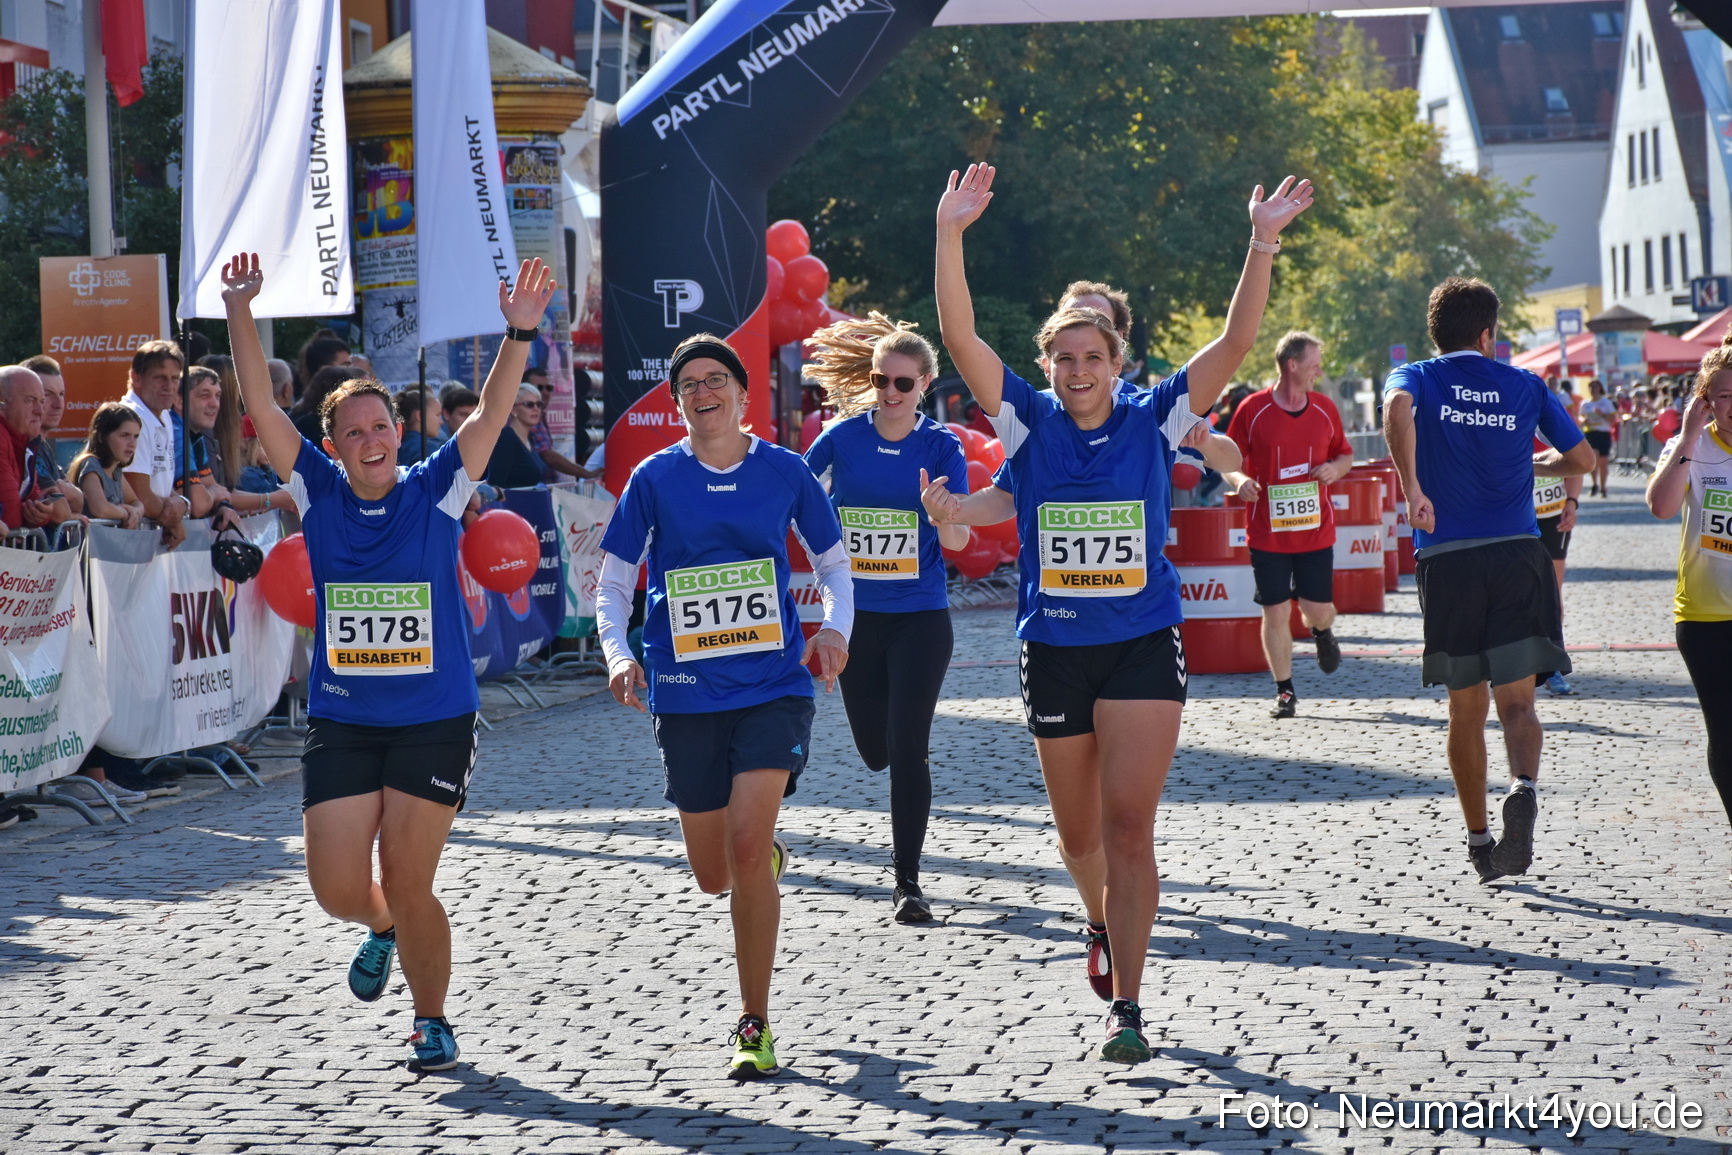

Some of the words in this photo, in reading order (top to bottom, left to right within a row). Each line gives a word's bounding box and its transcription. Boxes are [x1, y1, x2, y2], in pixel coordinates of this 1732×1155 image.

[651, 72, 743, 141] PARTL
[737, 0, 866, 81] NEUMAR
[465, 115, 499, 242] NEUMARKT
[316, 213, 339, 297] PARTL
[103, 269, 127, 279] CODE
[103, 279, 132, 288] CLINIC
[641, 358, 662, 370] THE
[627, 369, 643, 381] 100
[1451, 385, 1500, 403] Team
[628, 412, 665, 426] BMW
[1440, 404, 1517, 431] Parsberg
[707, 482, 737, 492] hummel
[1272, 485, 1316, 499] BOCK
[1534, 485, 1562, 504] 190
[1275, 498, 1316, 516] 5189
[844, 510, 911, 527] BOCK
[1046, 506, 1136, 528] BOCK
[1280, 517, 1314, 527] THOMAS
[849, 531, 908, 555] 5177
[1051, 535, 1133, 565] 5175
[857, 561, 899, 572] HANNA
[674, 563, 767, 594] BOCK
[1060, 573, 1125, 586] VERENA
[333, 587, 422, 608] BOCK
[683, 592, 767, 629] 5176
[339, 615, 420, 643] 5178
[697, 630, 760, 648] REGINA
[337, 651, 422, 664] ELISABETH
[1036, 712, 1065, 723] hummel
[430, 776, 458, 793] hummel
